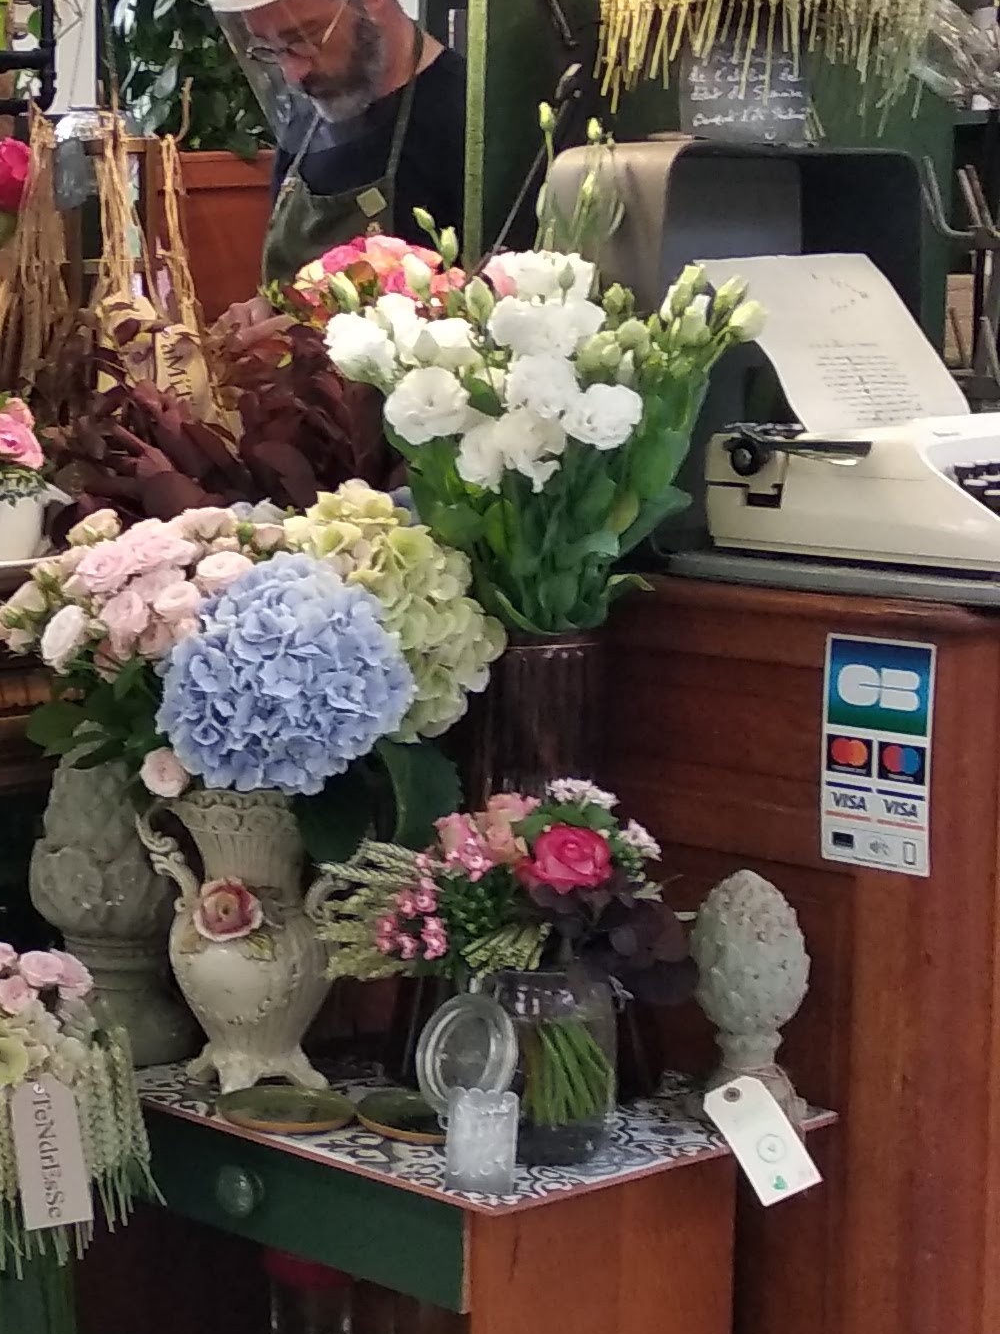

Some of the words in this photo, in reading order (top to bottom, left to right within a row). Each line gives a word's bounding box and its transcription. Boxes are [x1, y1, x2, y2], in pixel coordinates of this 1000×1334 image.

[837, 664, 920, 712] CB
[831, 791, 868, 812] VISA
[882, 798, 919, 819] VISA
